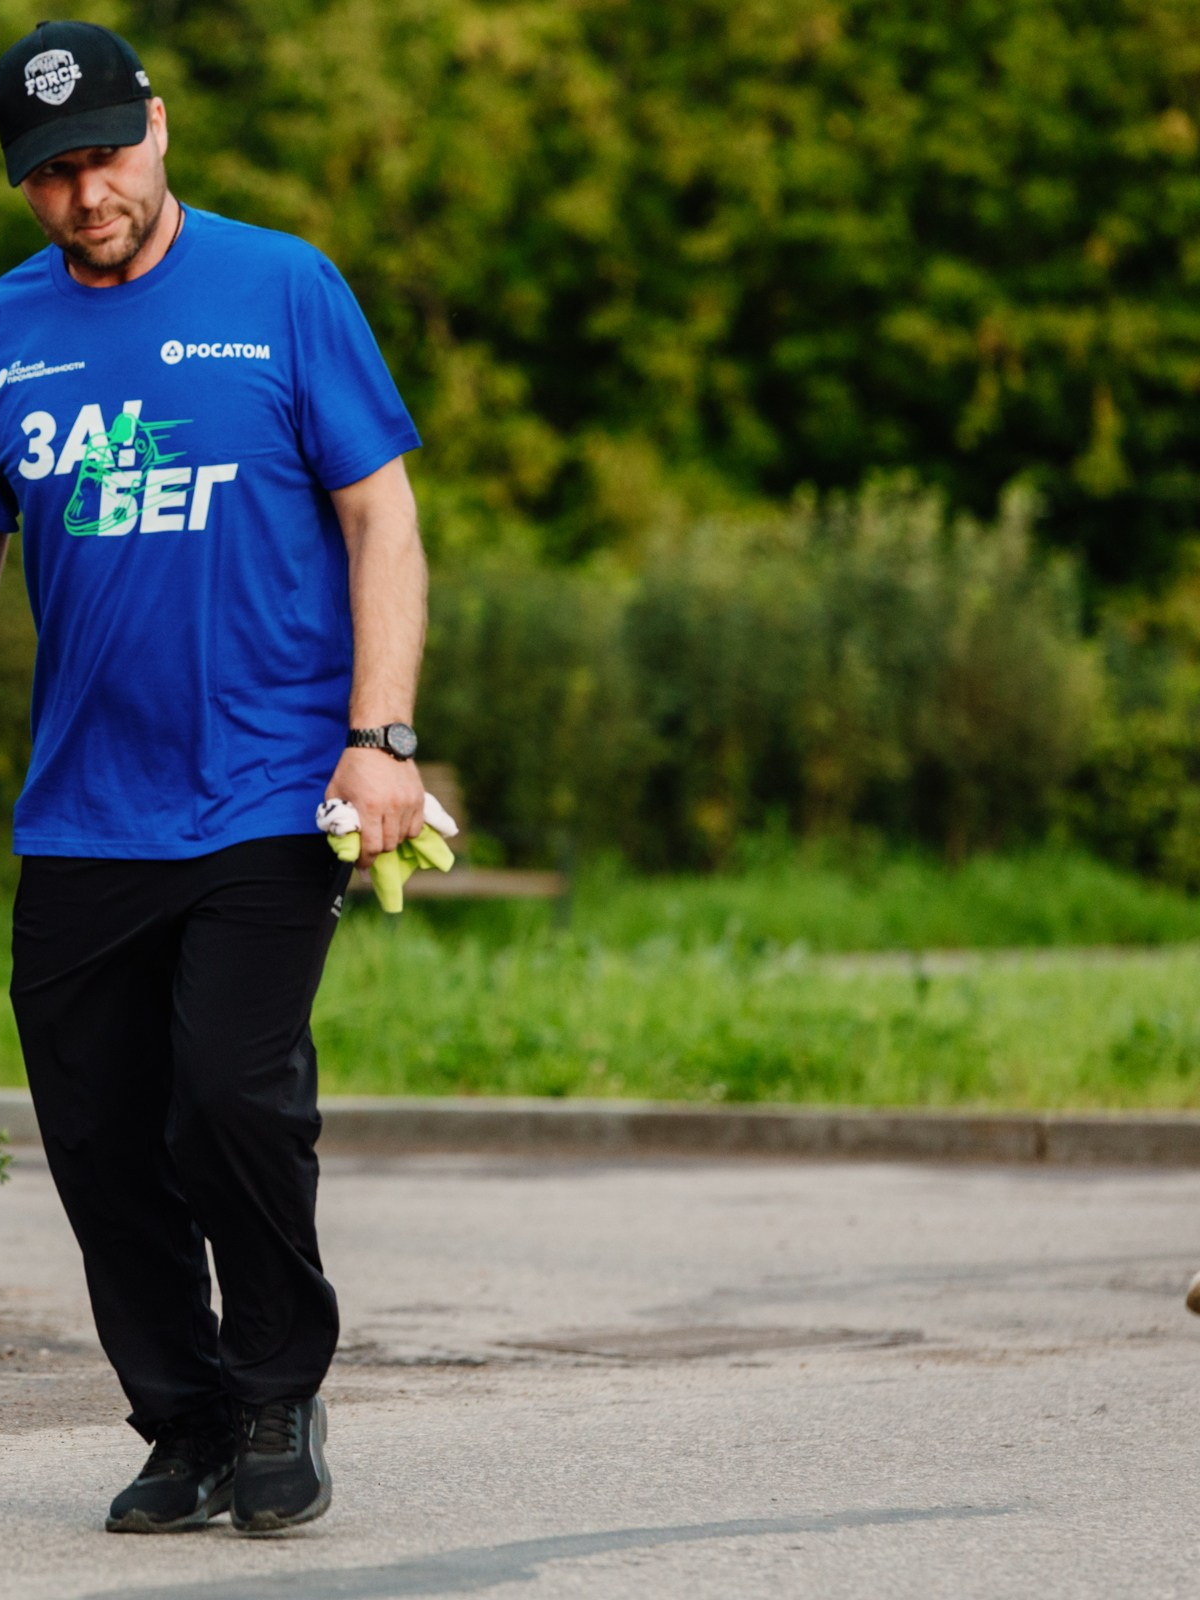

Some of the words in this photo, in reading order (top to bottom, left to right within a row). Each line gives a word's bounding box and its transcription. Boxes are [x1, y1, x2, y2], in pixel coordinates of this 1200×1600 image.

[25, 64, 82, 96] FORCE
[186, 343, 270, 359] РОСАТОМ
[18, 400, 142, 480] ЗА!
[97, 463, 238, 536] БЕГ
